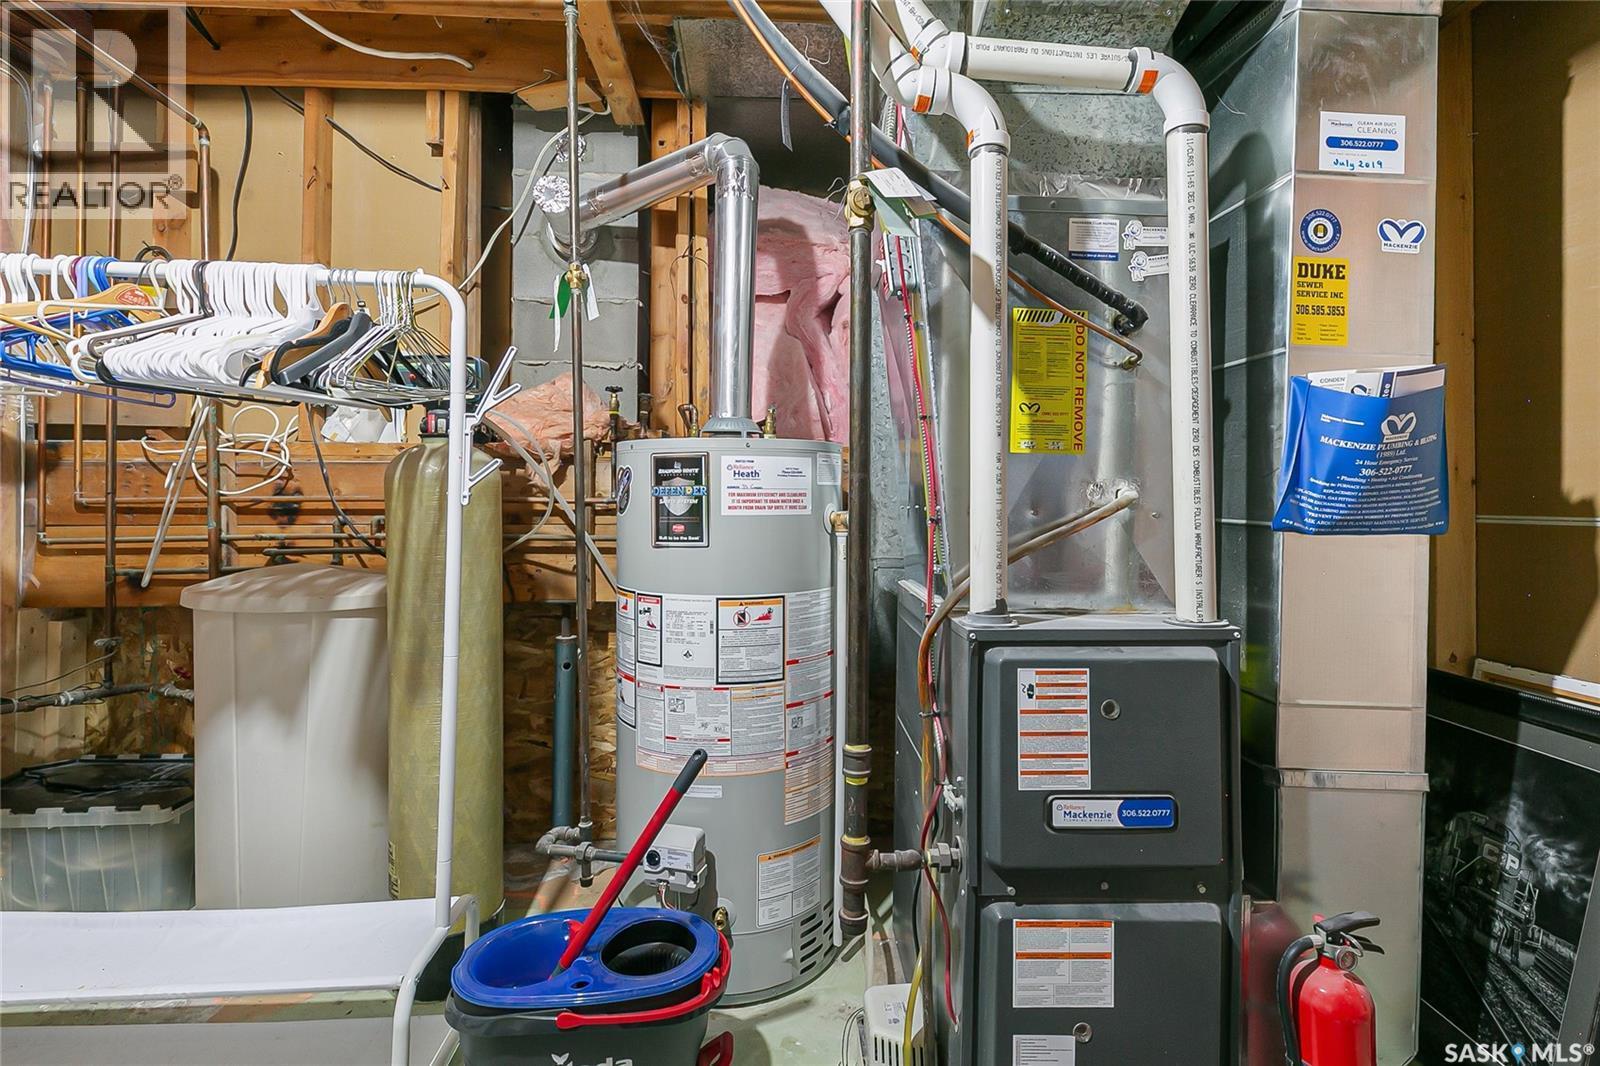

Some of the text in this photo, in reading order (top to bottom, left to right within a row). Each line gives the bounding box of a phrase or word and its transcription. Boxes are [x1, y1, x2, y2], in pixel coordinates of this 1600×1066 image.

[1357, 126, 1397, 135] CLEANING
[1340, 139, 1384, 148] 306.522.0777
[1333, 158, 1383, 171] July 2019
[1297, 262, 1345, 280] DUKE
[1188, 276, 1198, 290] ZERO
[1296, 281, 1323, 289] SEWER
[1296, 290, 1344, 299] SERVICE INC
[1295, 304, 1345, 316] 306.585.3853
[1190, 330, 1198, 338] TO
[1073, 325, 1085, 451] DO NOT REMOVE
[1192, 428, 1200, 442] ZERO
[1320, 435, 1377, 451] MACKENZIE
[1377, 439, 1413, 451] PLUMBING
[1192, 446, 1201, 457] DES
[733, 469, 760, 478] Heath
[1359, 464, 1413, 477] 306-522-0777
[1192, 460, 1201, 504] COMBUSTIBLES
[652, 485, 708, 496] DEFENDER
[1193, 507, 1202, 530] FOLLOW
[1063, 809, 1171, 819] Mackenzie 306.522.0777
